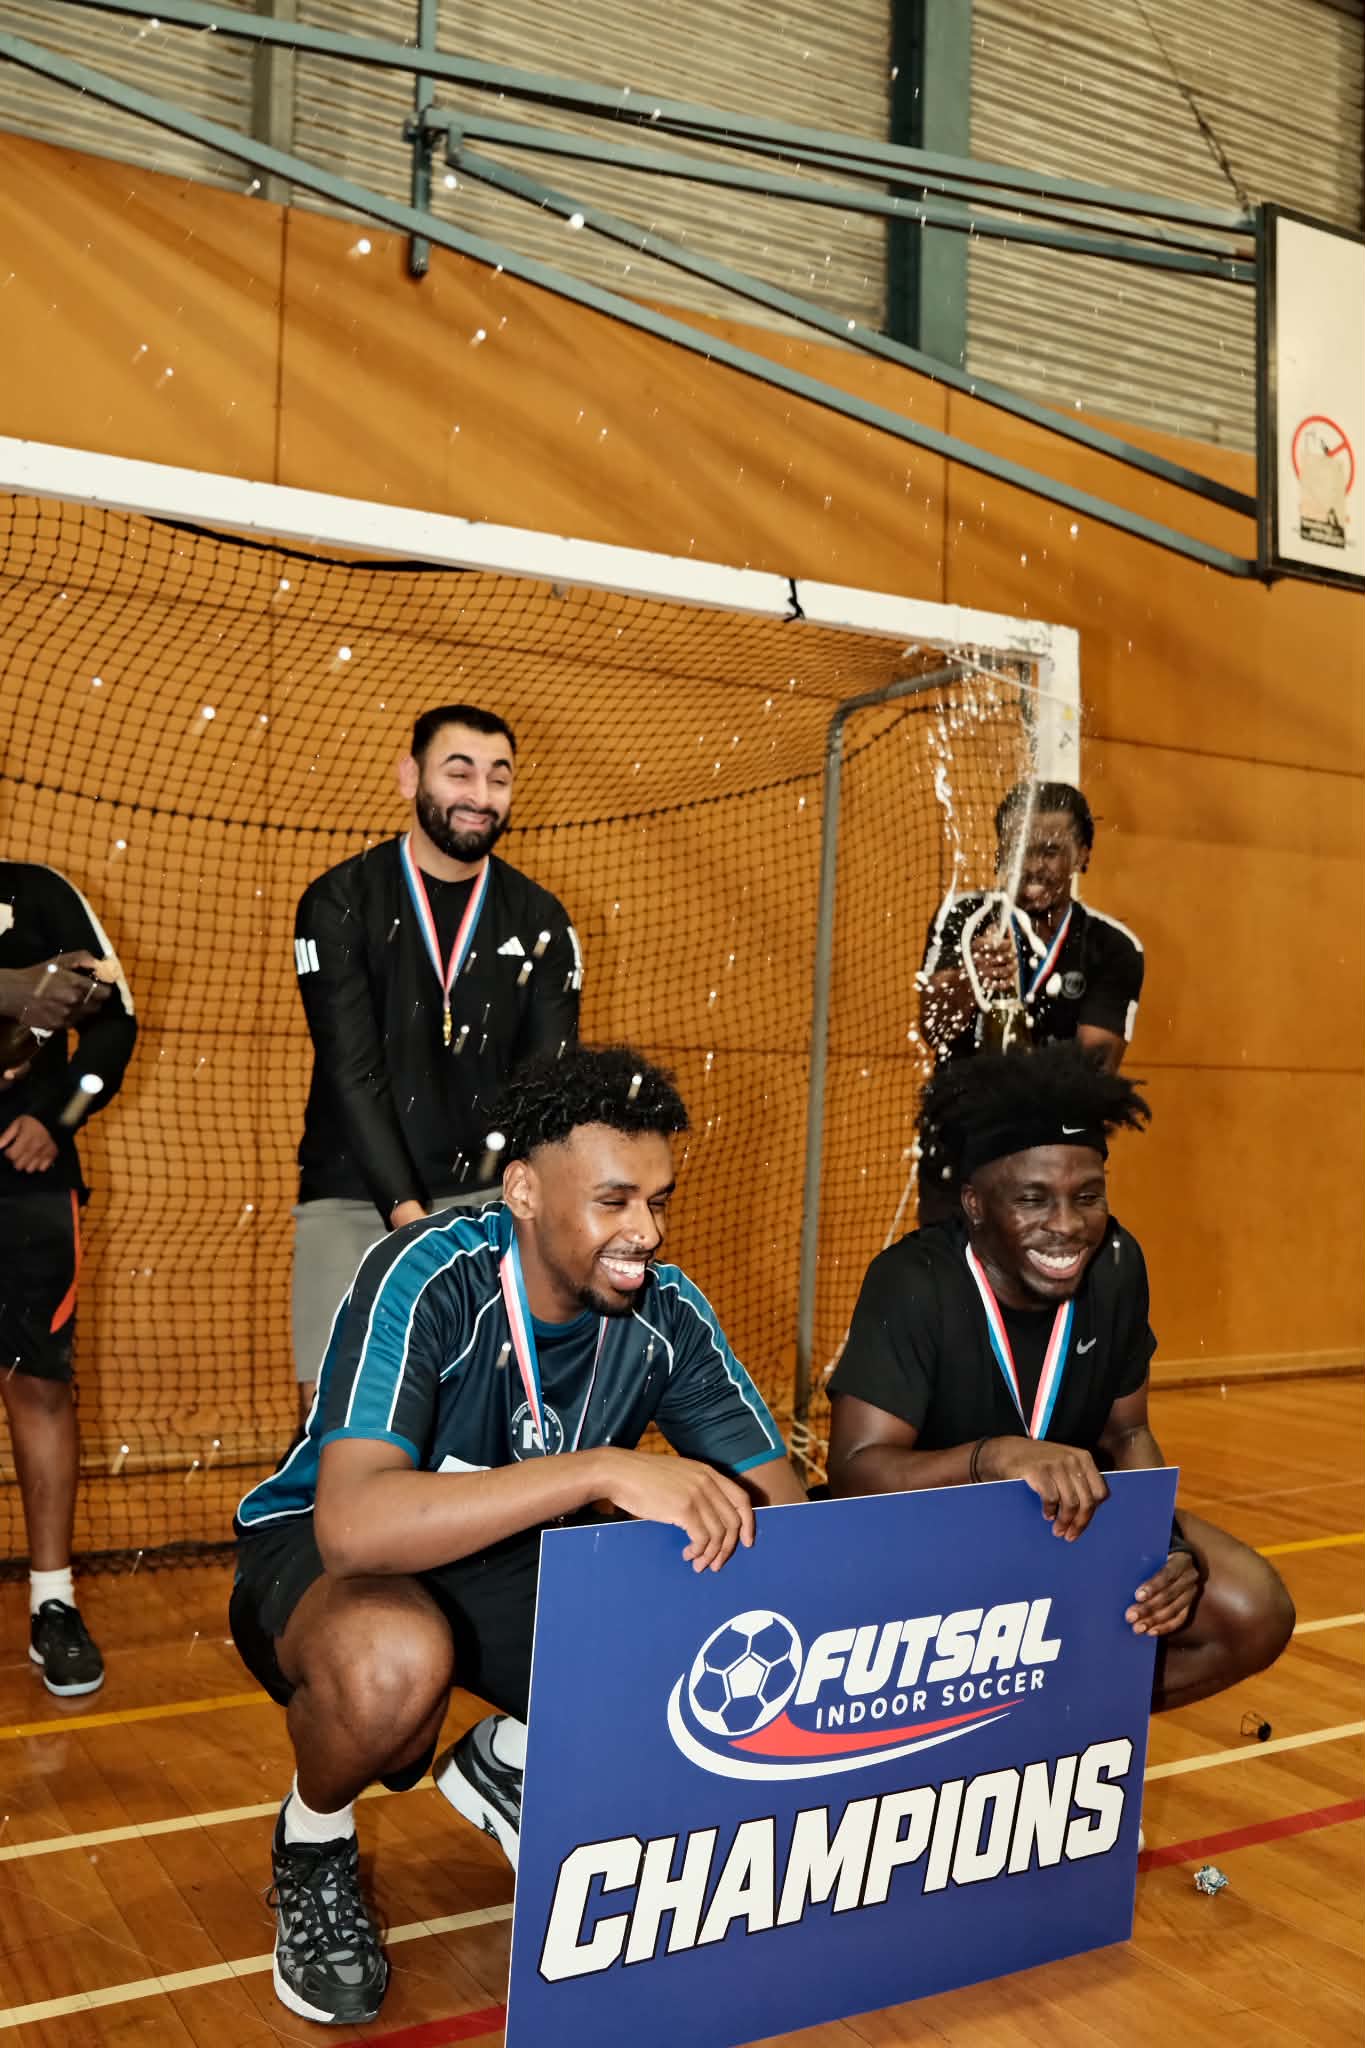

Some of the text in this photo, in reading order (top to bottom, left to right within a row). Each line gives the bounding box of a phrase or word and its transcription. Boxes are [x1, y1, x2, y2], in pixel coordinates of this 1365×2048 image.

[794, 1597, 1062, 1706] FUTSAL
[816, 1669, 1045, 1729] INDOOR SOCCER
[538, 1738, 1133, 1983] CHAMPIONS
